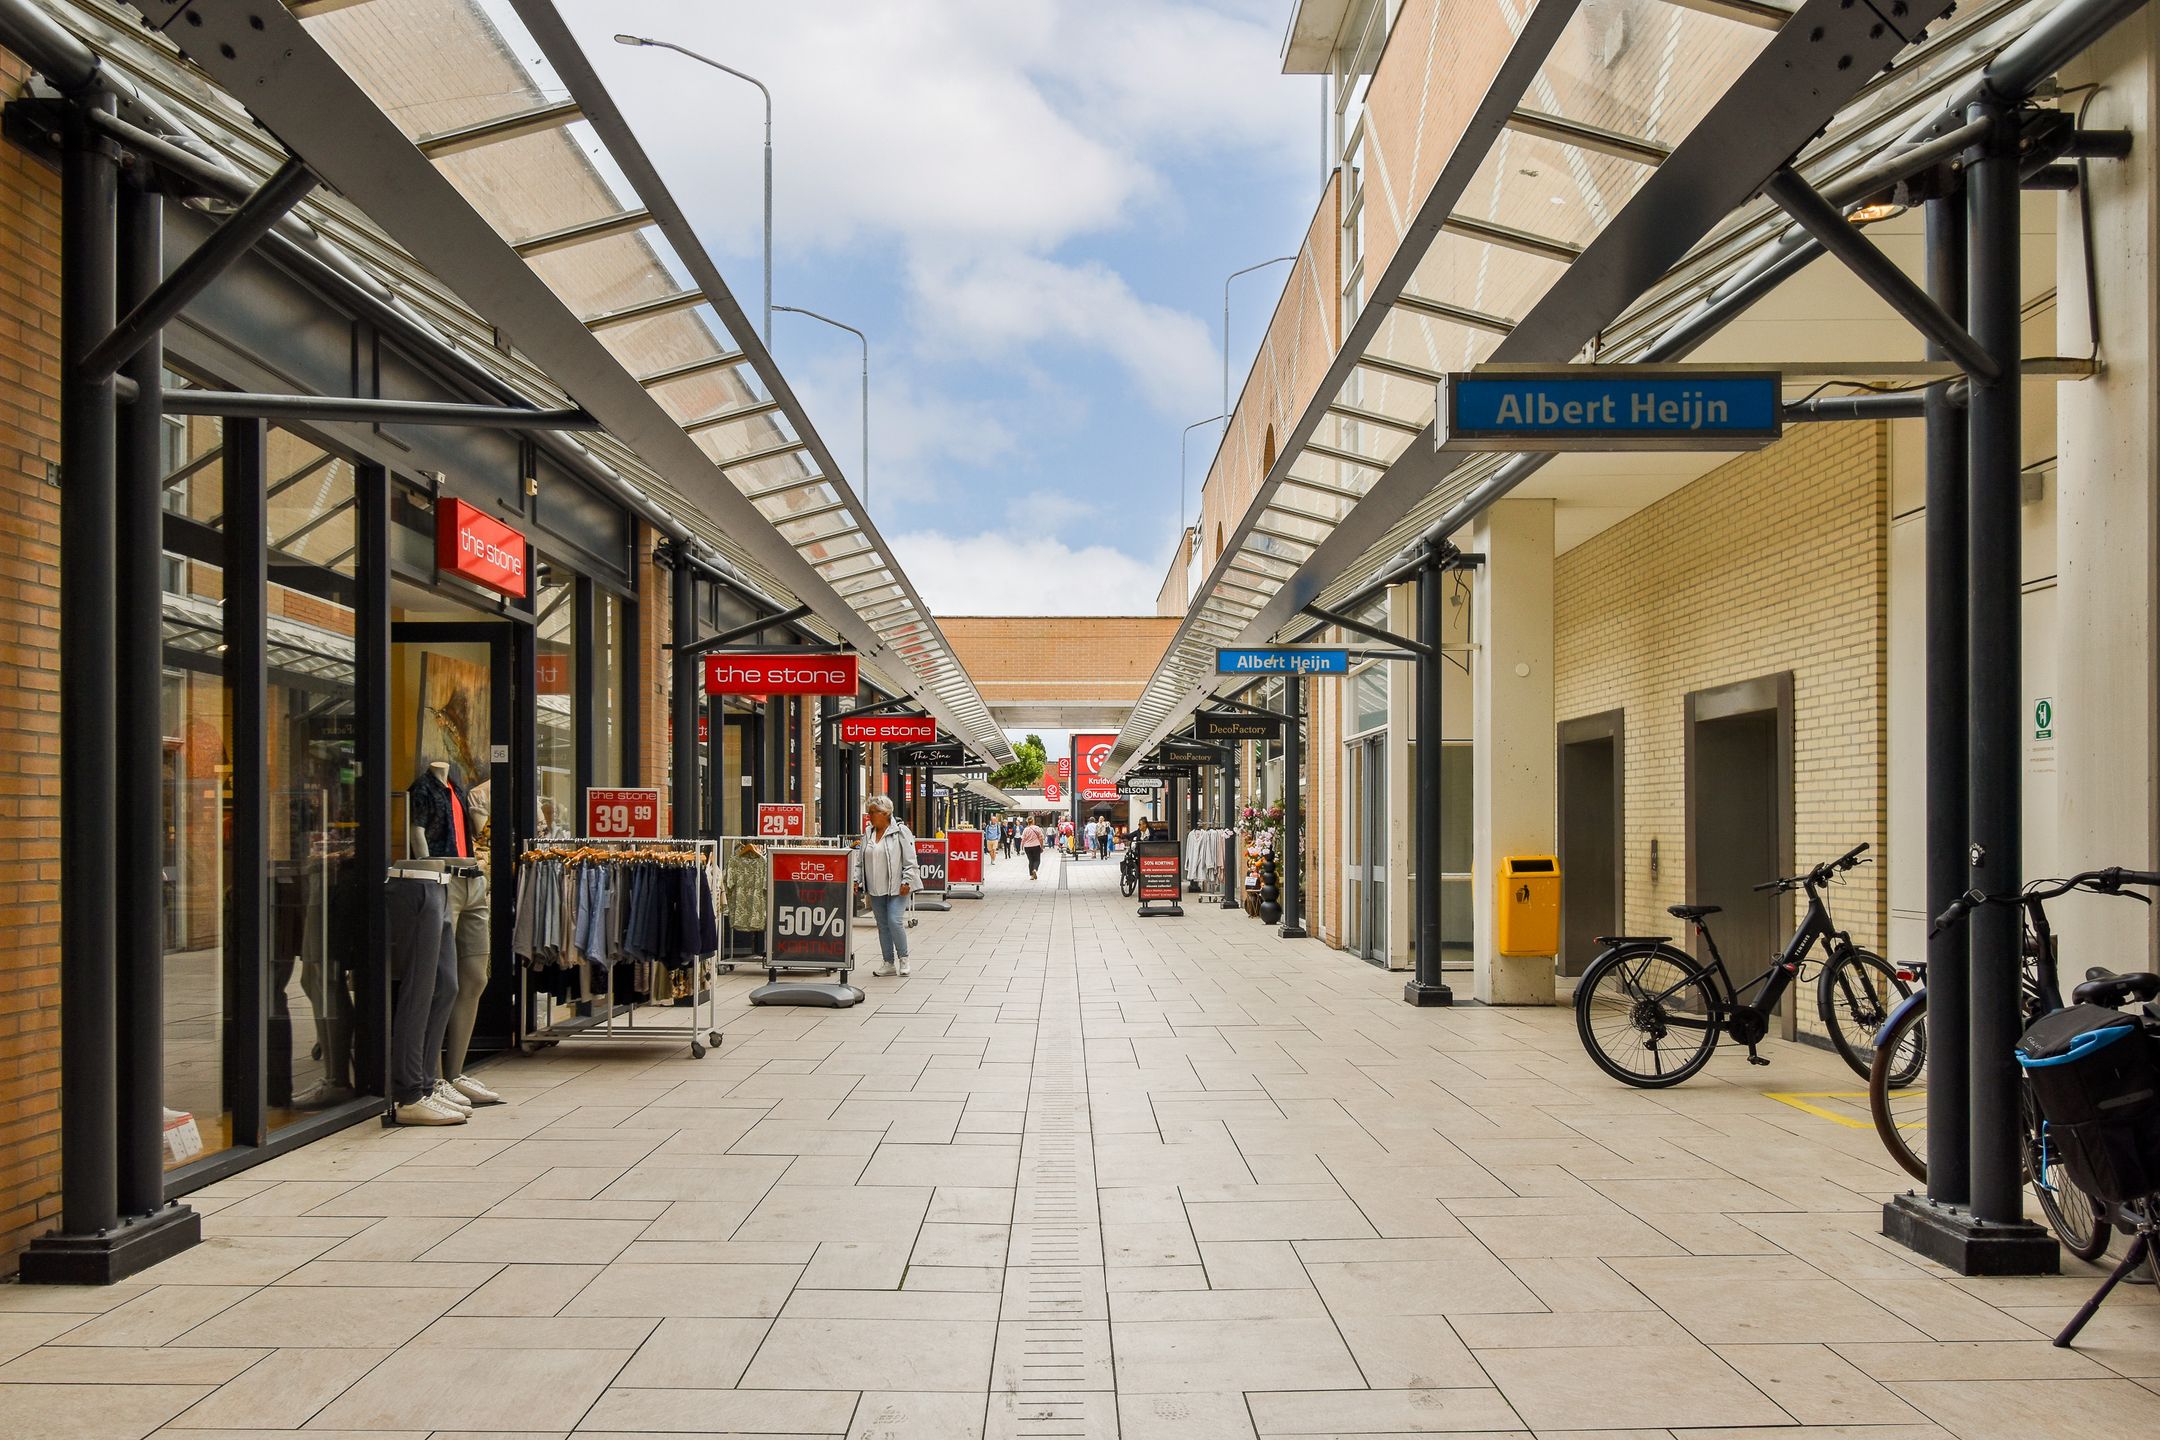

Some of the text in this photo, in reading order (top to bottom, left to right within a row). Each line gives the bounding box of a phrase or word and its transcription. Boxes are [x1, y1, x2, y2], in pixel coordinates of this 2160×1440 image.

[1496, 392, 1728, 430] Albert Heijn
[461, 527, 522, 577] the stone
[1236, 654, 1330, 671] Albert Heijn
[715, 665, 846, 684] the stone
[846, 724, 932, 736] the stone
[1209, 723, 1267, 735] DecoFactory
[910, 750, 951, 760] The Stone
[1169, 752, 1212, 761] DecoFactory
[590, 791, 657, 800] the stone
[950, 851, 978, 861] SALE
[800, 860, 825, 871] the
[791, 871, 834, 881] stone
[920, 864, 944, 880] 0%
[778, 905, 845, 937] 50%
